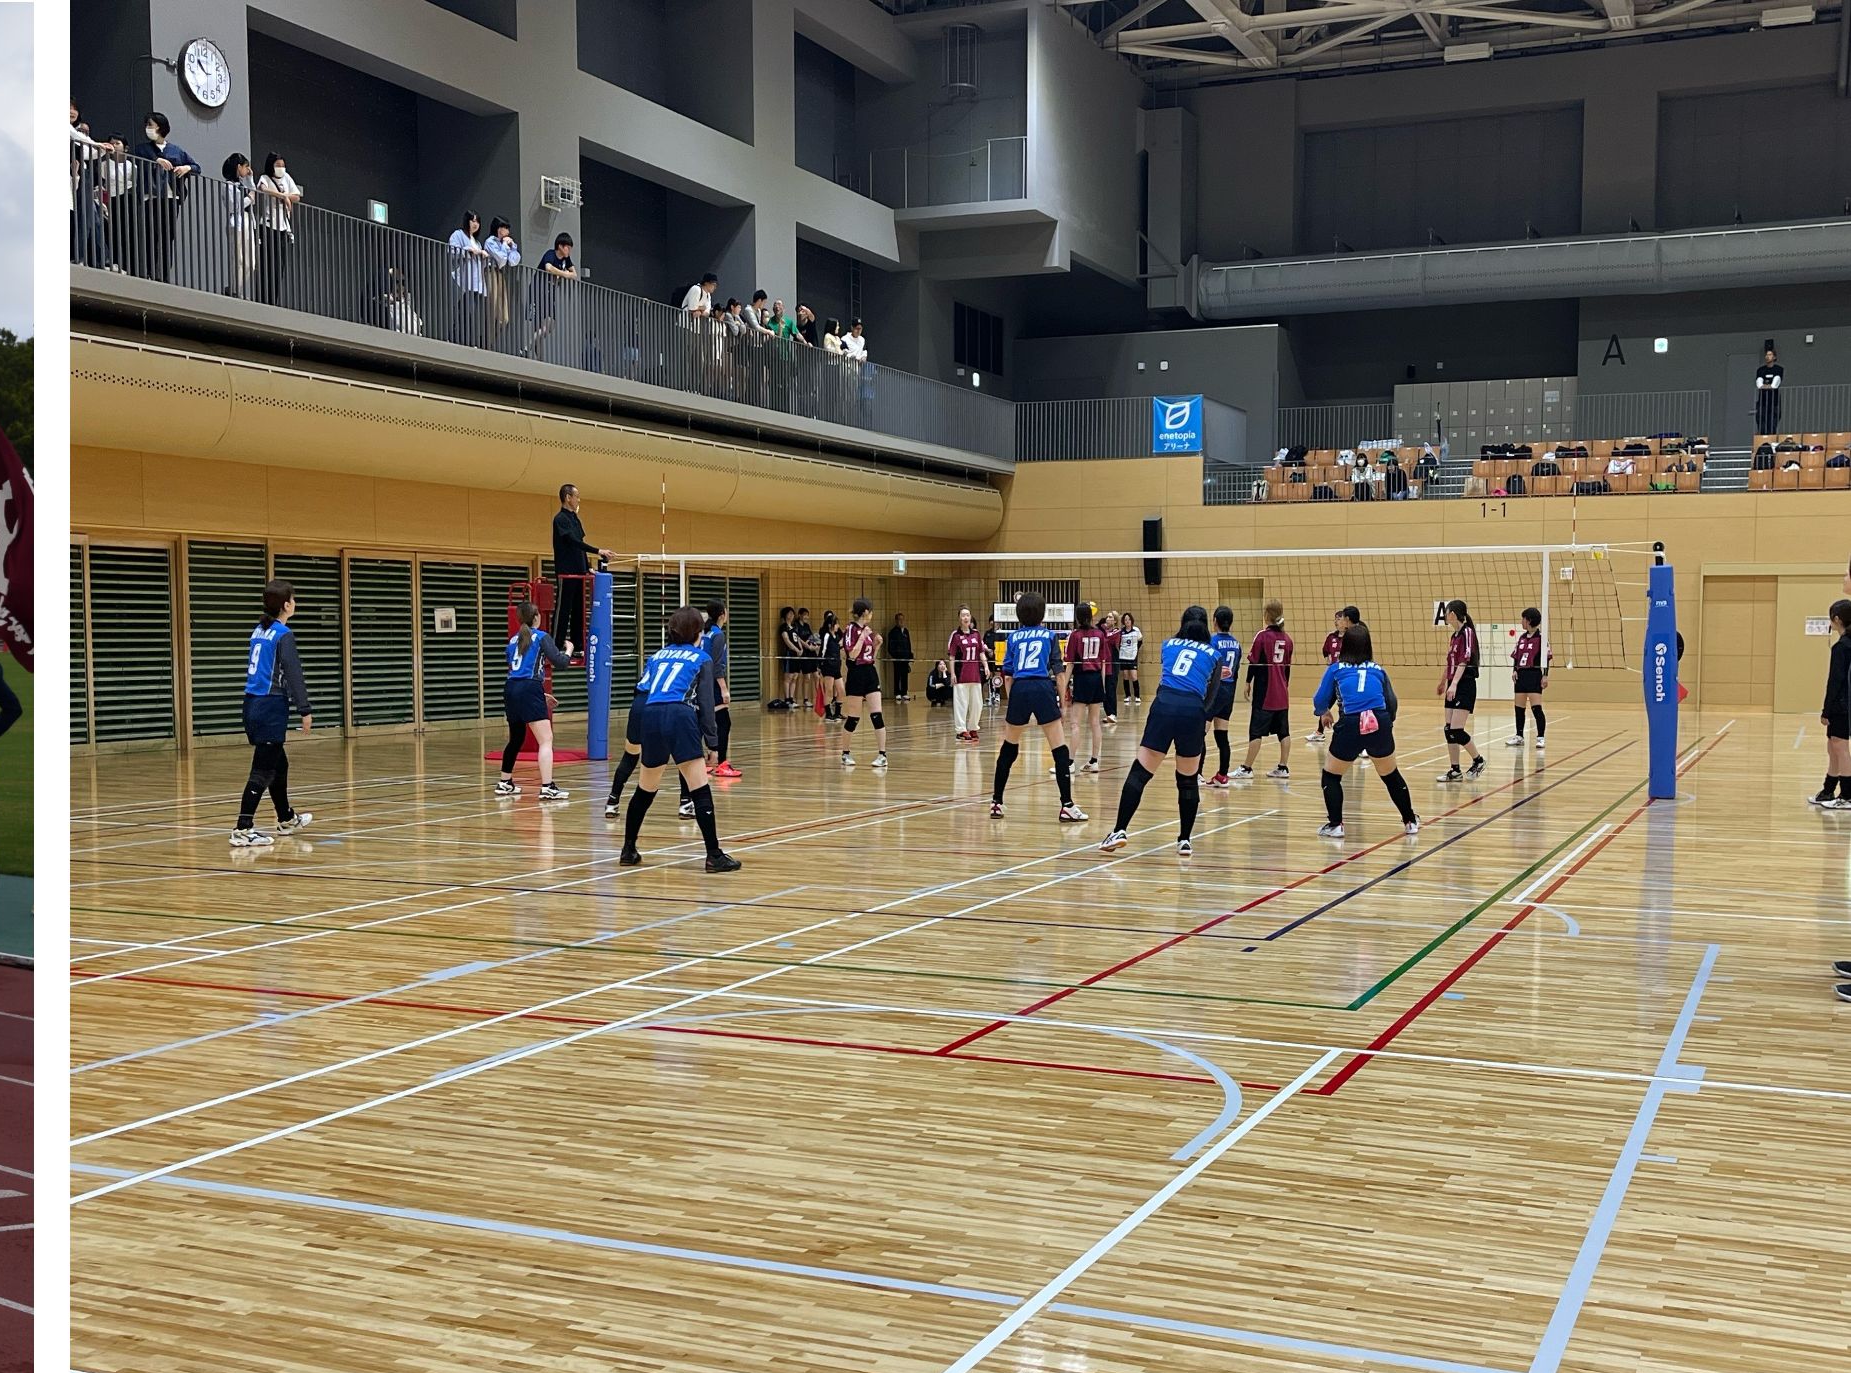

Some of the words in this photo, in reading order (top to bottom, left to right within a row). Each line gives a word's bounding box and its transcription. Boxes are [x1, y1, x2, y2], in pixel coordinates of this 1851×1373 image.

[1602, 334, 1626, 366] A
[1159, 431, 1196, 442] enetopia
[1164, 442, 1190, 450] アリーナ
[1481, 502, 1507, 518] 1-1
[1434, 601, 1449, 626] A
[1012, 630, 1050, 643] KOYAMA
[1167, 637, 1215, 656] KOYAMA
[1218, 640, 1240, 650] KOYAMA
[248, 643, 262, 675] 9
[652, 649, 700, 663] KOYAMA
[863, 645, 873, 661] 2
[965, 647, 976, 661] 11
[1017, 640, 1043, 671] 12
[1082, 637, 1101, 660] 10
[1273, 640, 1286, 663] 5
[589, 645, 597, 683] Senoh
[1172, 649, 1198, 677] 6
[1226, 651, 1236, 671] 7
[650, 662, 685, 694] 11
[1357, 669, 1367, 692] 1
[1655, 656, 1668, 702] Senoh
